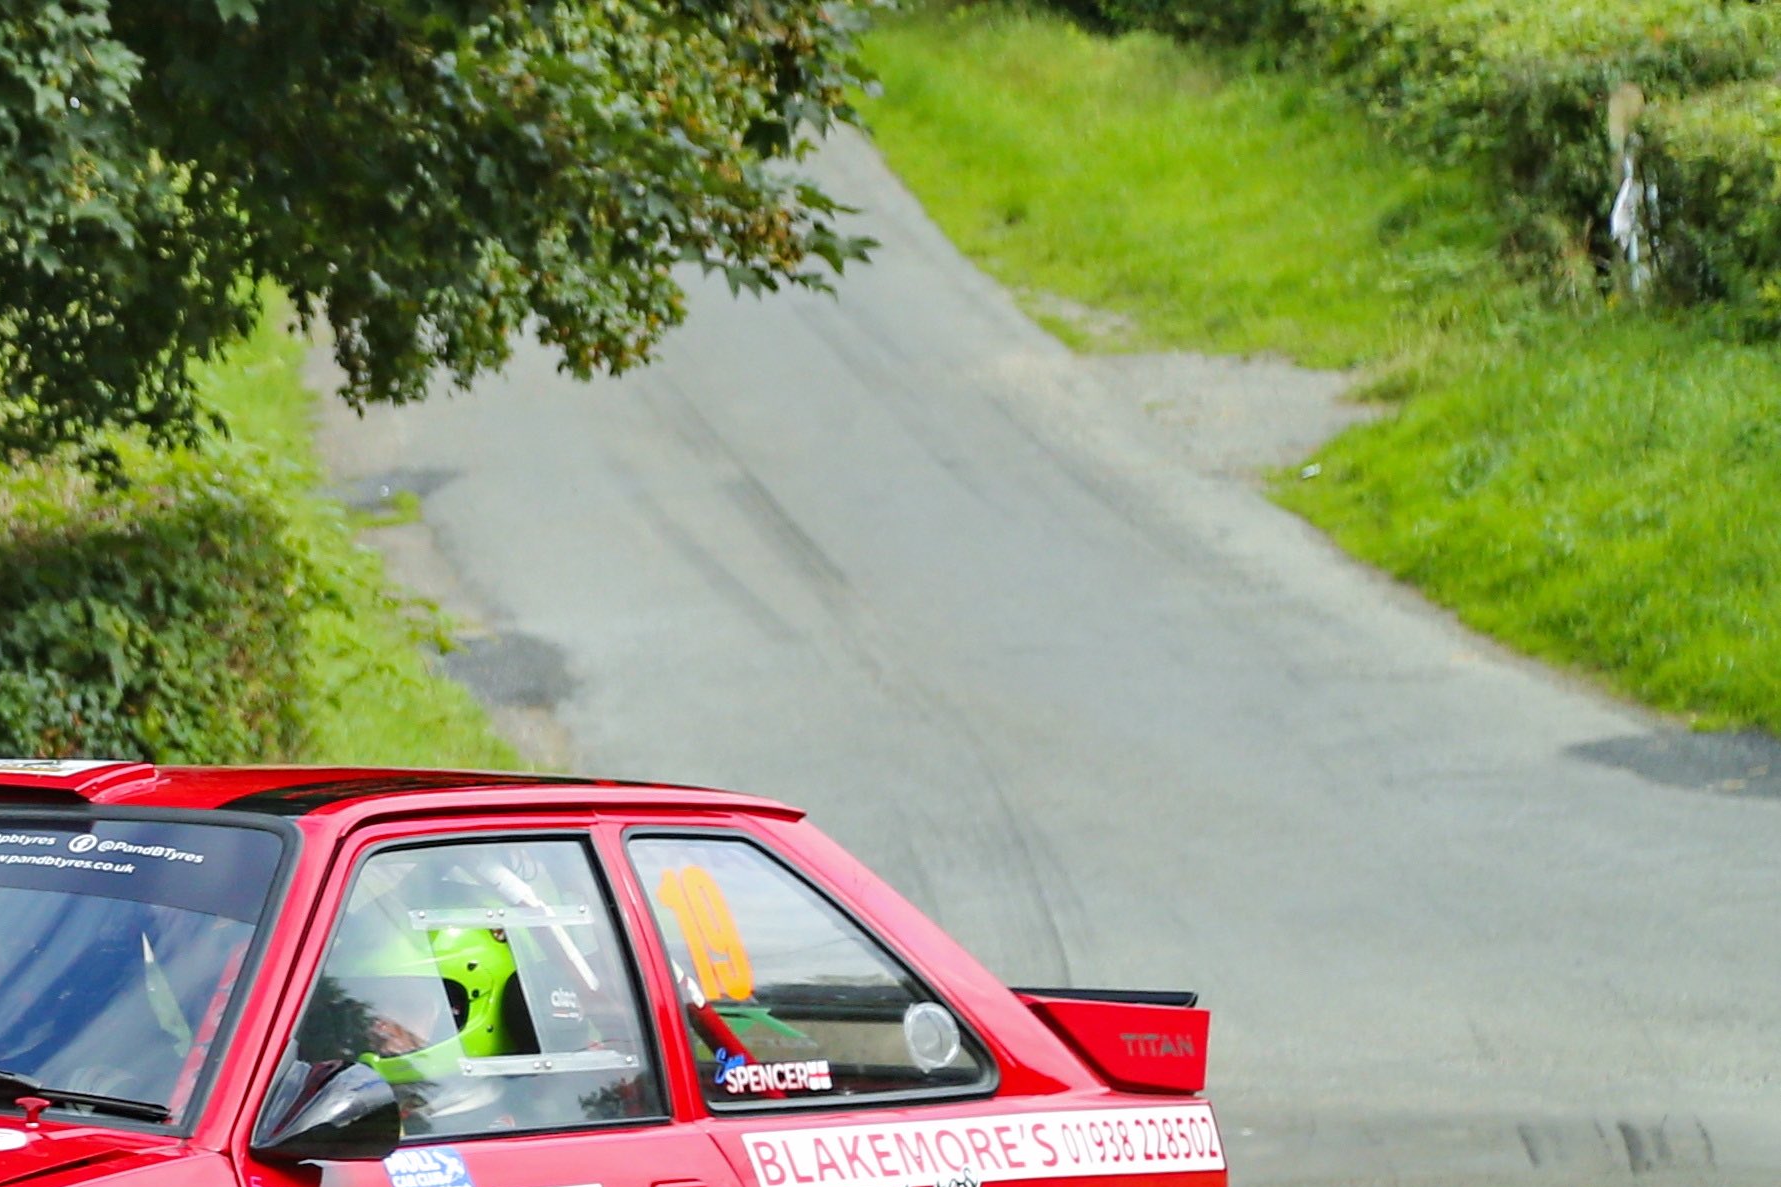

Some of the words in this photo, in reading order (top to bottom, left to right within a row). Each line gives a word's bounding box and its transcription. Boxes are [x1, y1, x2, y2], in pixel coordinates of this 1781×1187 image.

[97, 840, 204, 864] @PandBTyres
[657, 865, 755, 1001] 19
[1120, 1033, 1195, 1056] TITAN
[724, 1062, 810, 1094] SPENCER
[755, 1124, 1059, 1186] BLAKEMORE'S
[1061, 1120, 1133, 1165] 01938
[1134, 1116, 1218, 1160] 228502
